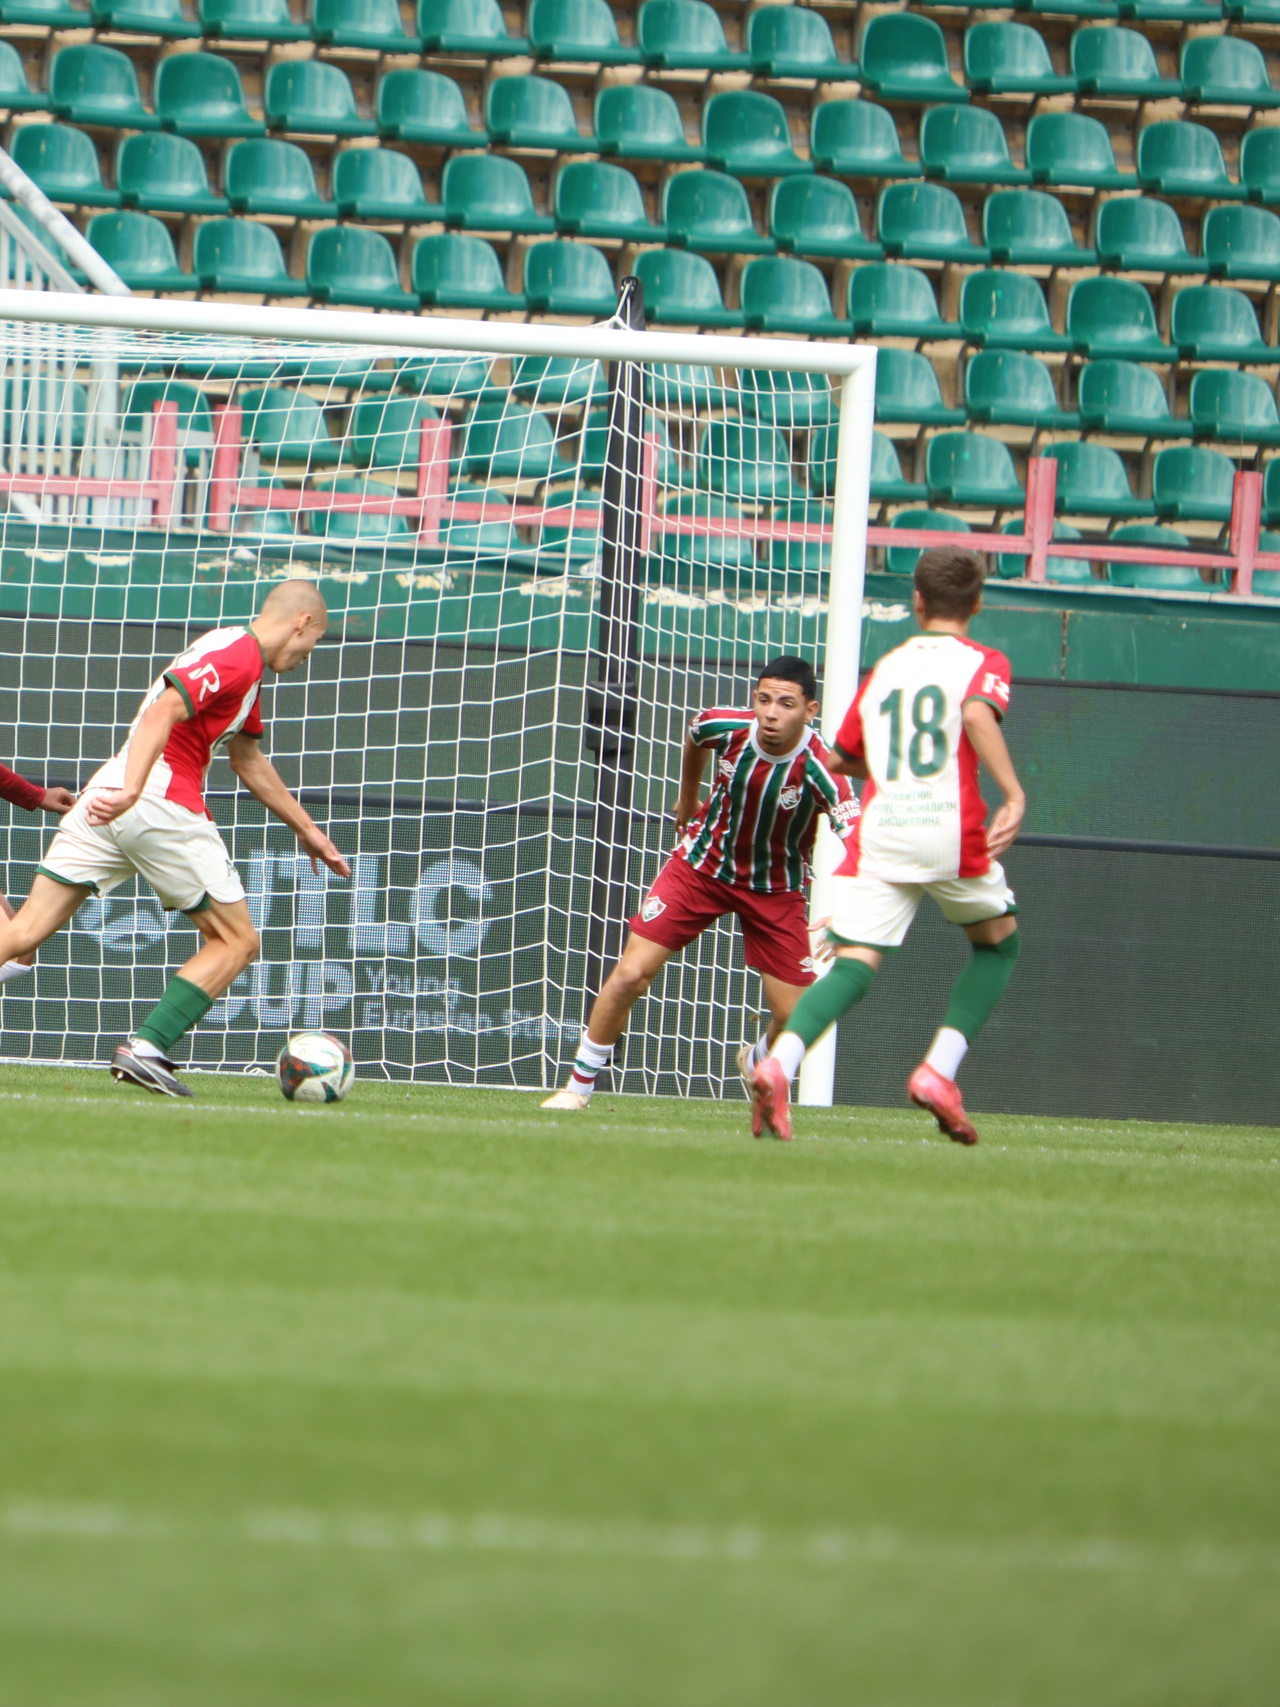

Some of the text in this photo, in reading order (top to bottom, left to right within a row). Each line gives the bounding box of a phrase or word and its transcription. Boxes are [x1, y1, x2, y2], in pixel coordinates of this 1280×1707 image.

[880, 684, 948, 781] 18
[878, 815, 942, 828] ДИСЦИПЛИНА
[365, 965, 461, 1010] Young
[362, 1001, 493, 1036] Eurasian
